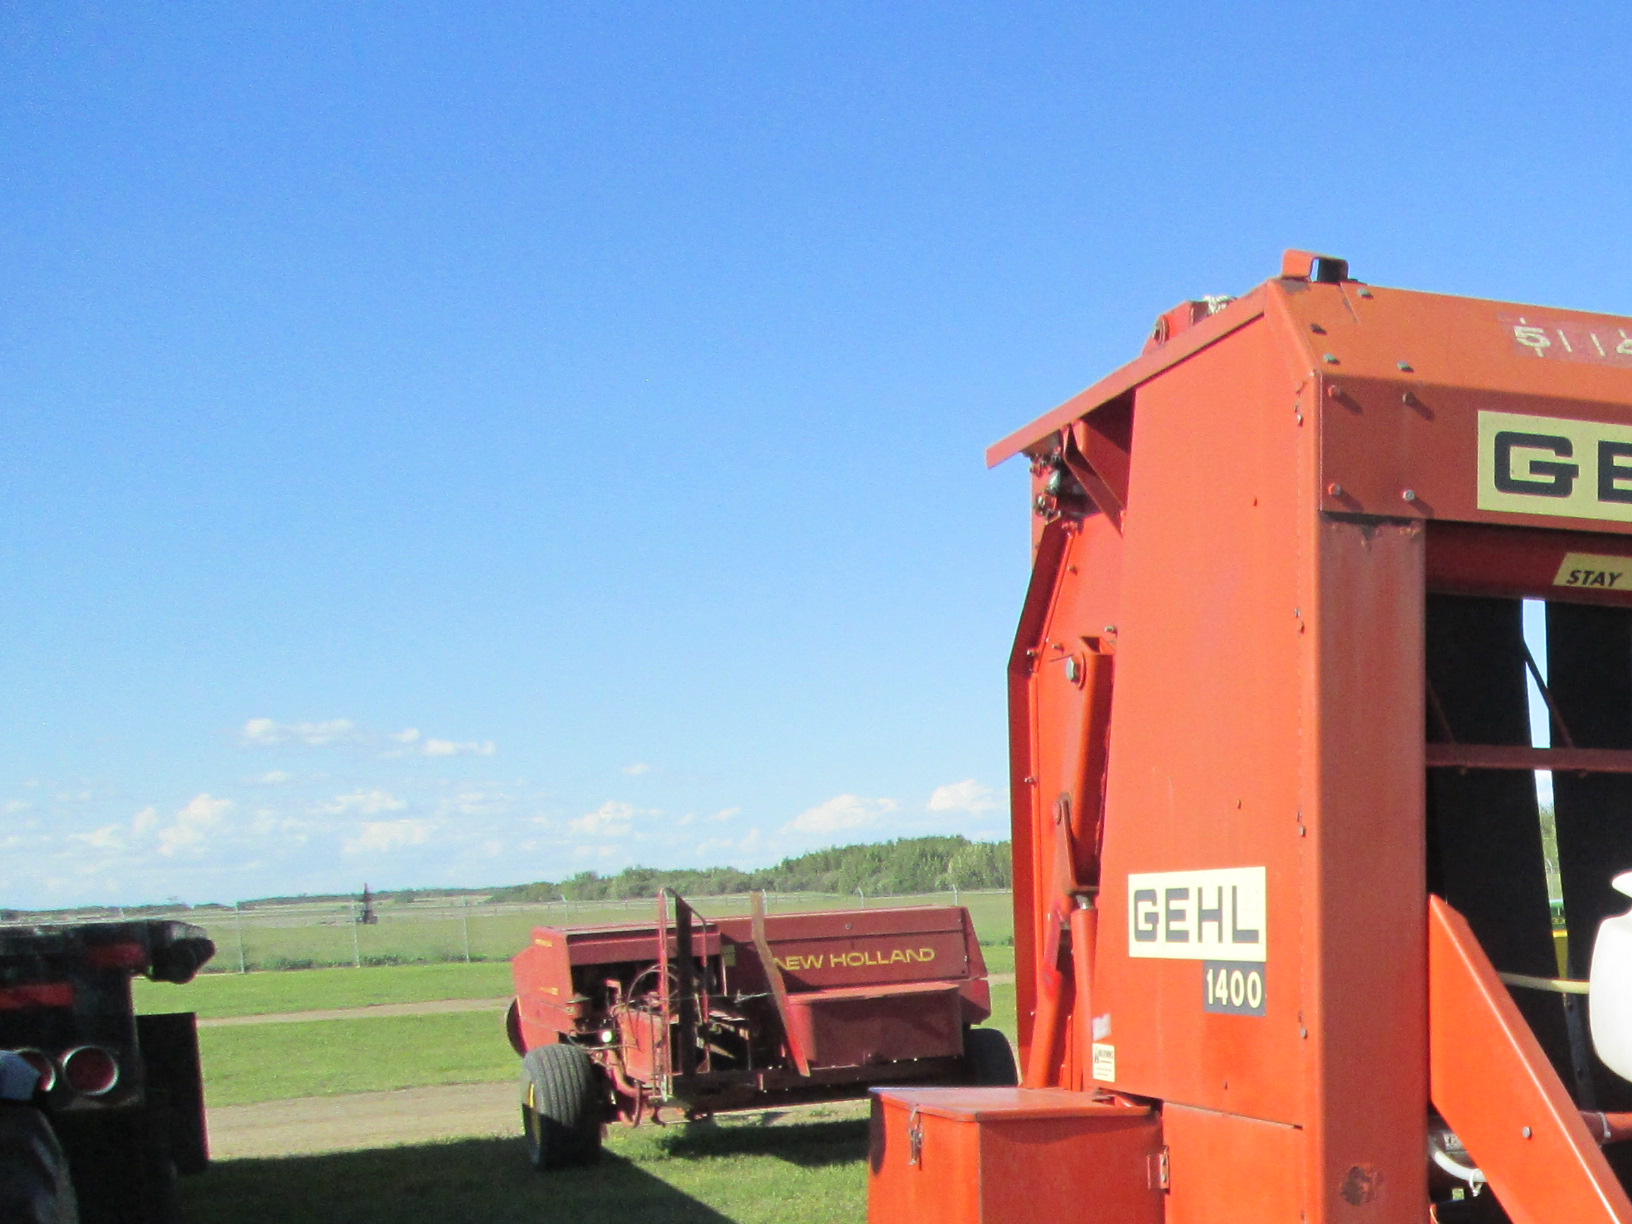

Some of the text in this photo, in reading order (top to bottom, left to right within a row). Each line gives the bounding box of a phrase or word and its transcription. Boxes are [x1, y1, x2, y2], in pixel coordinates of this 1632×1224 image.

[1566, 570, 1622, 588] STAY
[1134, 885, 1260, 943] GEHL
[830, 948, 936, 968] HOLLAND
[1206, 968, 1262, 1009] 1400
